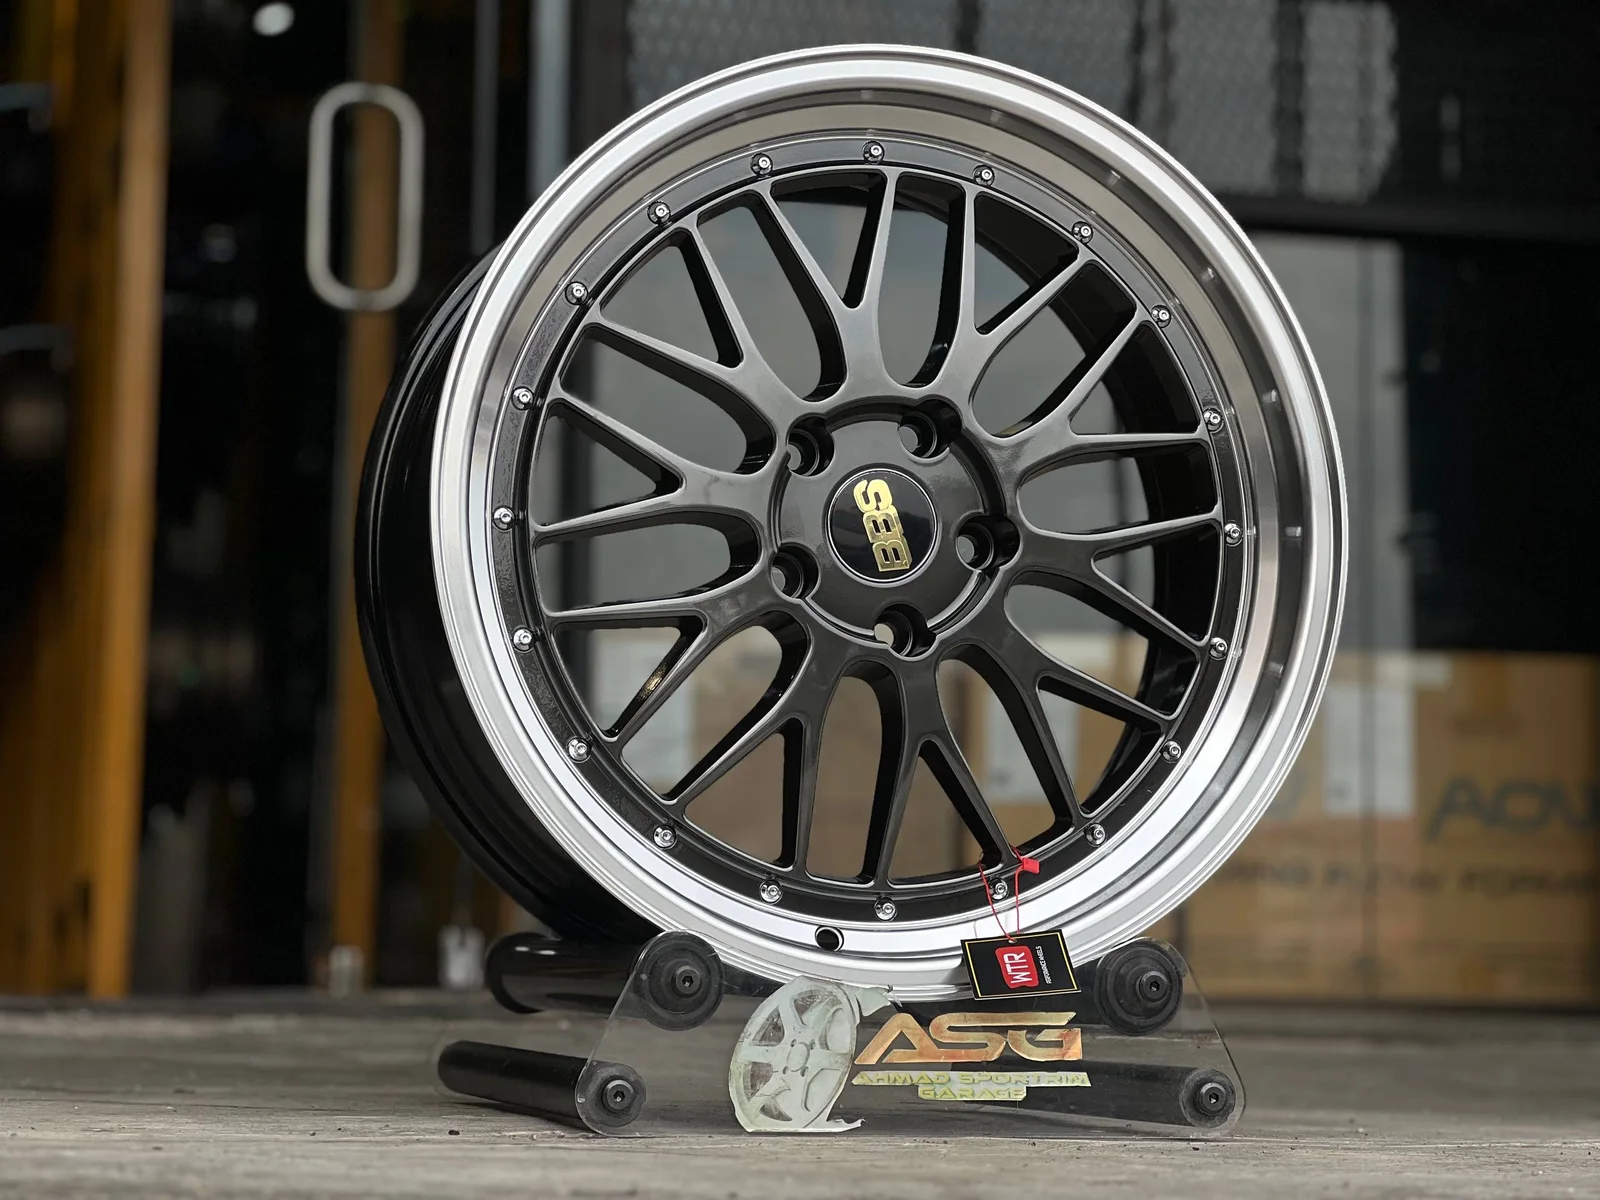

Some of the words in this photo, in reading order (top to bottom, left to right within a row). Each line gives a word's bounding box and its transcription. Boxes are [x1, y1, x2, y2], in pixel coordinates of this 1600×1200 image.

[853, 479, 912, 571] BBS
[1004, 952, 1032, 984] WTR
[854, 1012, 1083, 1064] ASG
[857, 1072, 950, 1084] AHMAD
[920, 1086, 1025, 1099] GARAGE
